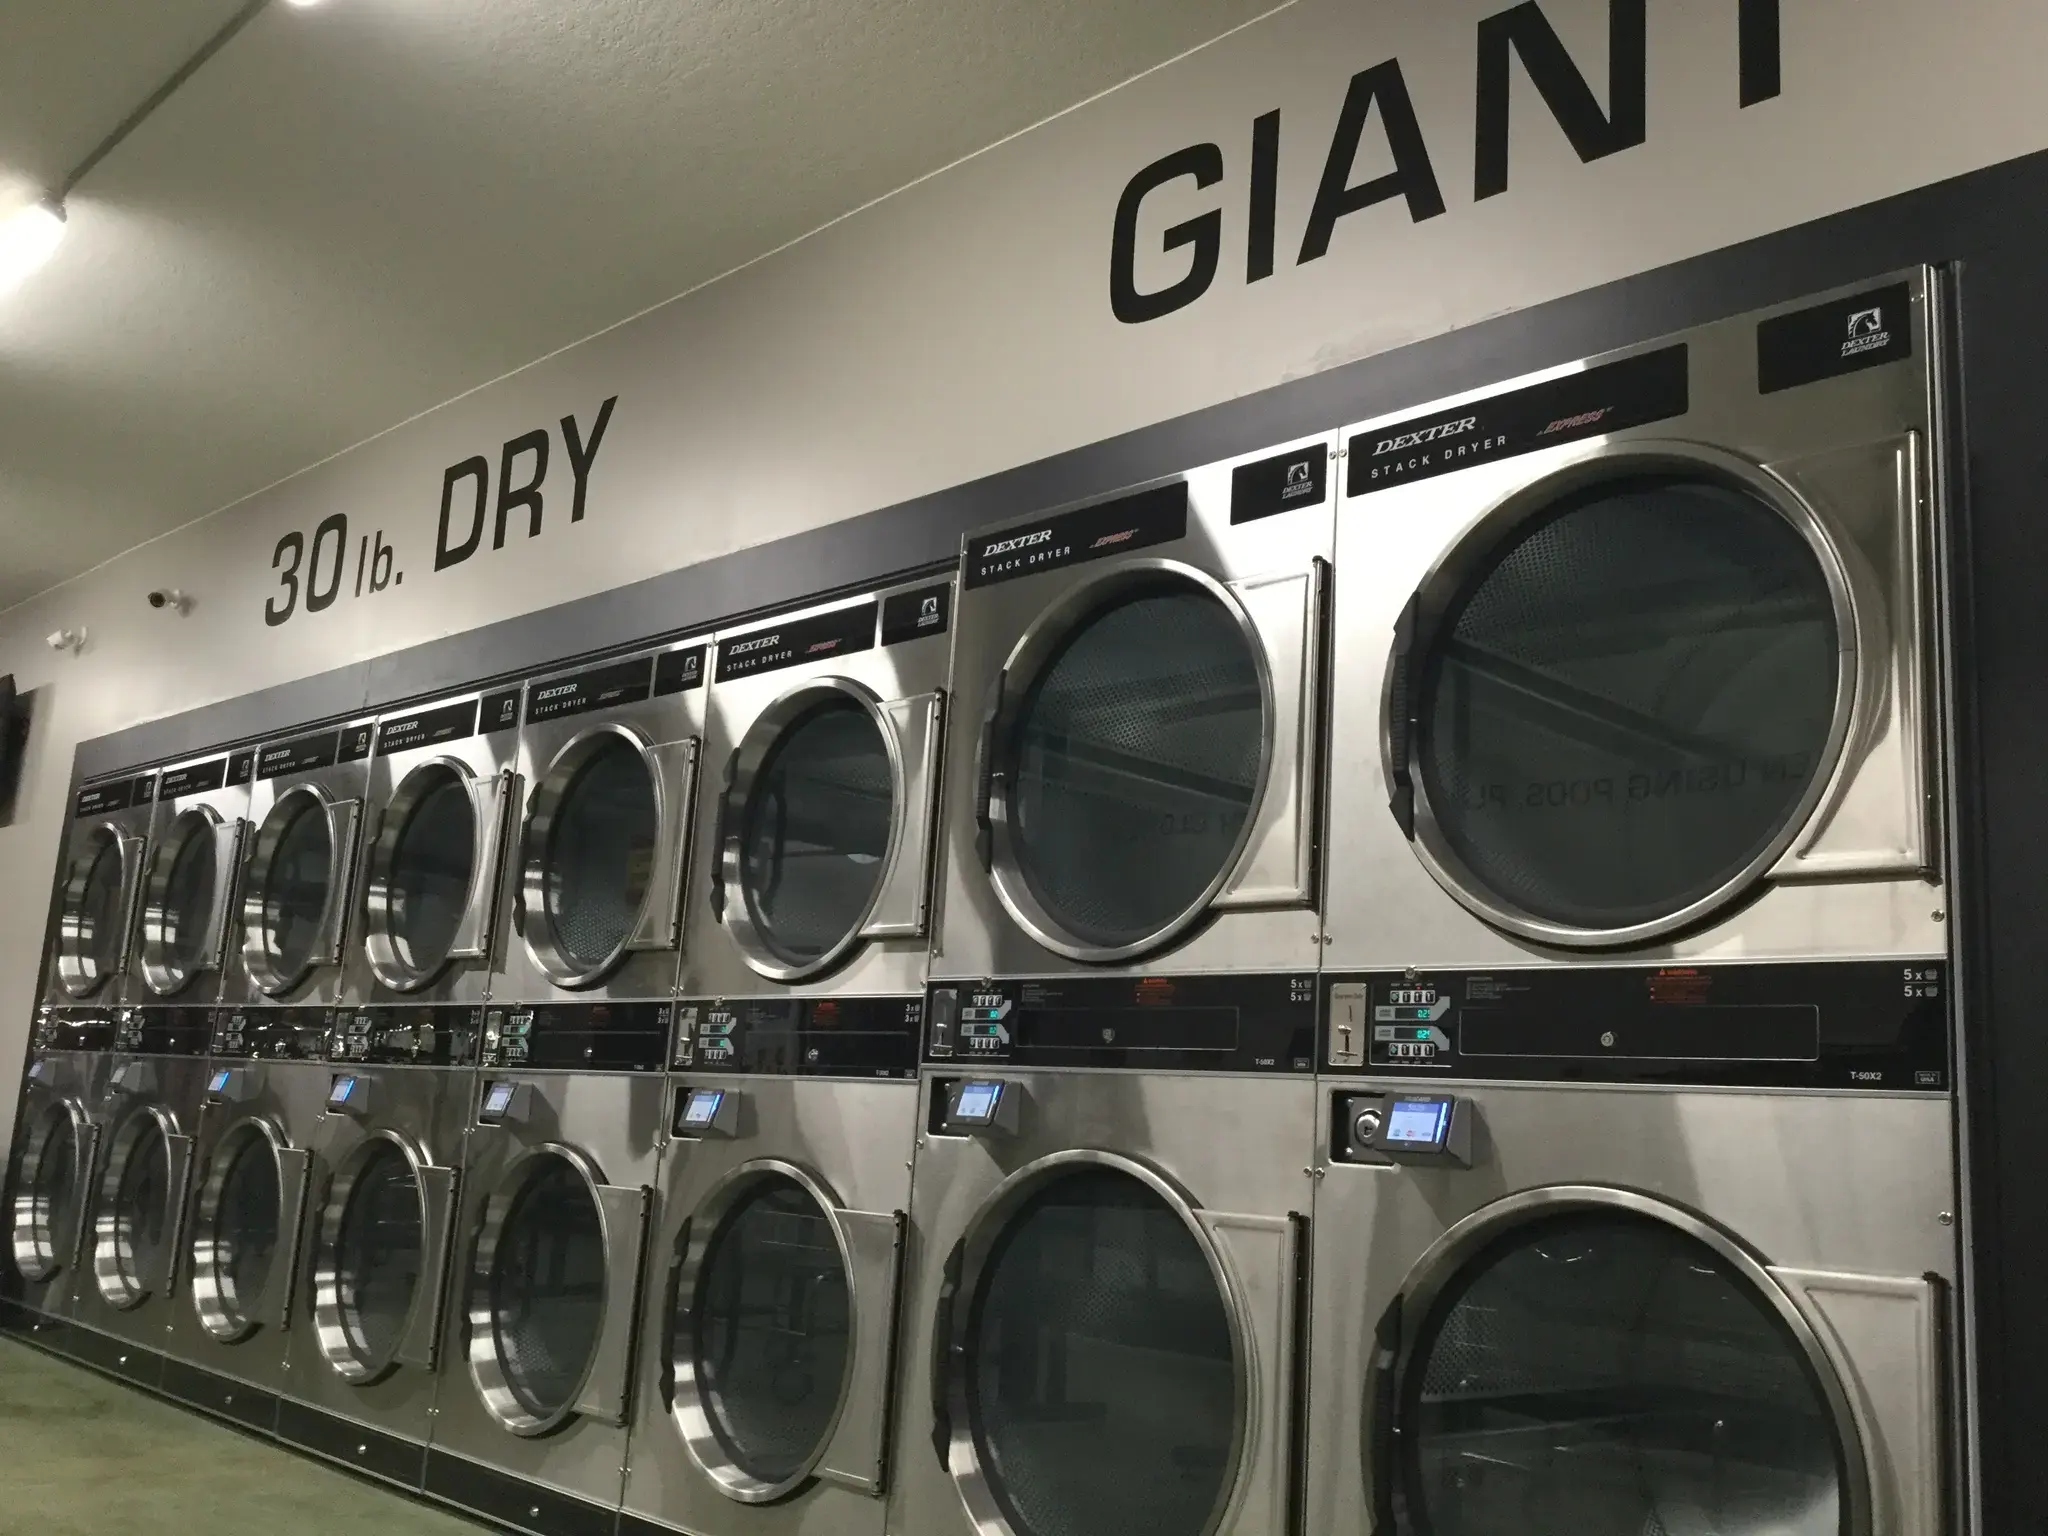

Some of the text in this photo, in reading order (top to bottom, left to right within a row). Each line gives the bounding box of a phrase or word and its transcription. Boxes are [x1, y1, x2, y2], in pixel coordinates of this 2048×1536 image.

[1840, 331, 1890, 351] DEXTER
[1371, 415, 1477, 457] DEXTER
[1370, 434, 1508, 479] STACK DRYER
[264, 394, 619, 627] 30 lb. DRY
[982, 529, 1052, 557] DEXTER
[980, 545, 1071, 576] STACK DRYER
[728, 634, 780, 656] DEXTER
[726, 650, 793, 672] STACK DRYER
[536, 683, 578, 701] DEXTER
[385, 720, 419, 736] DEXTER
[1290, 979, 1297, 989] 5
[1903, 968, 1923, 981] 5 x
[1290, 992, 1297, 1001] 5
[1903, 985, 1923, 997] 5 x
[1850, 1071, 1882, 1081] T-50X2
